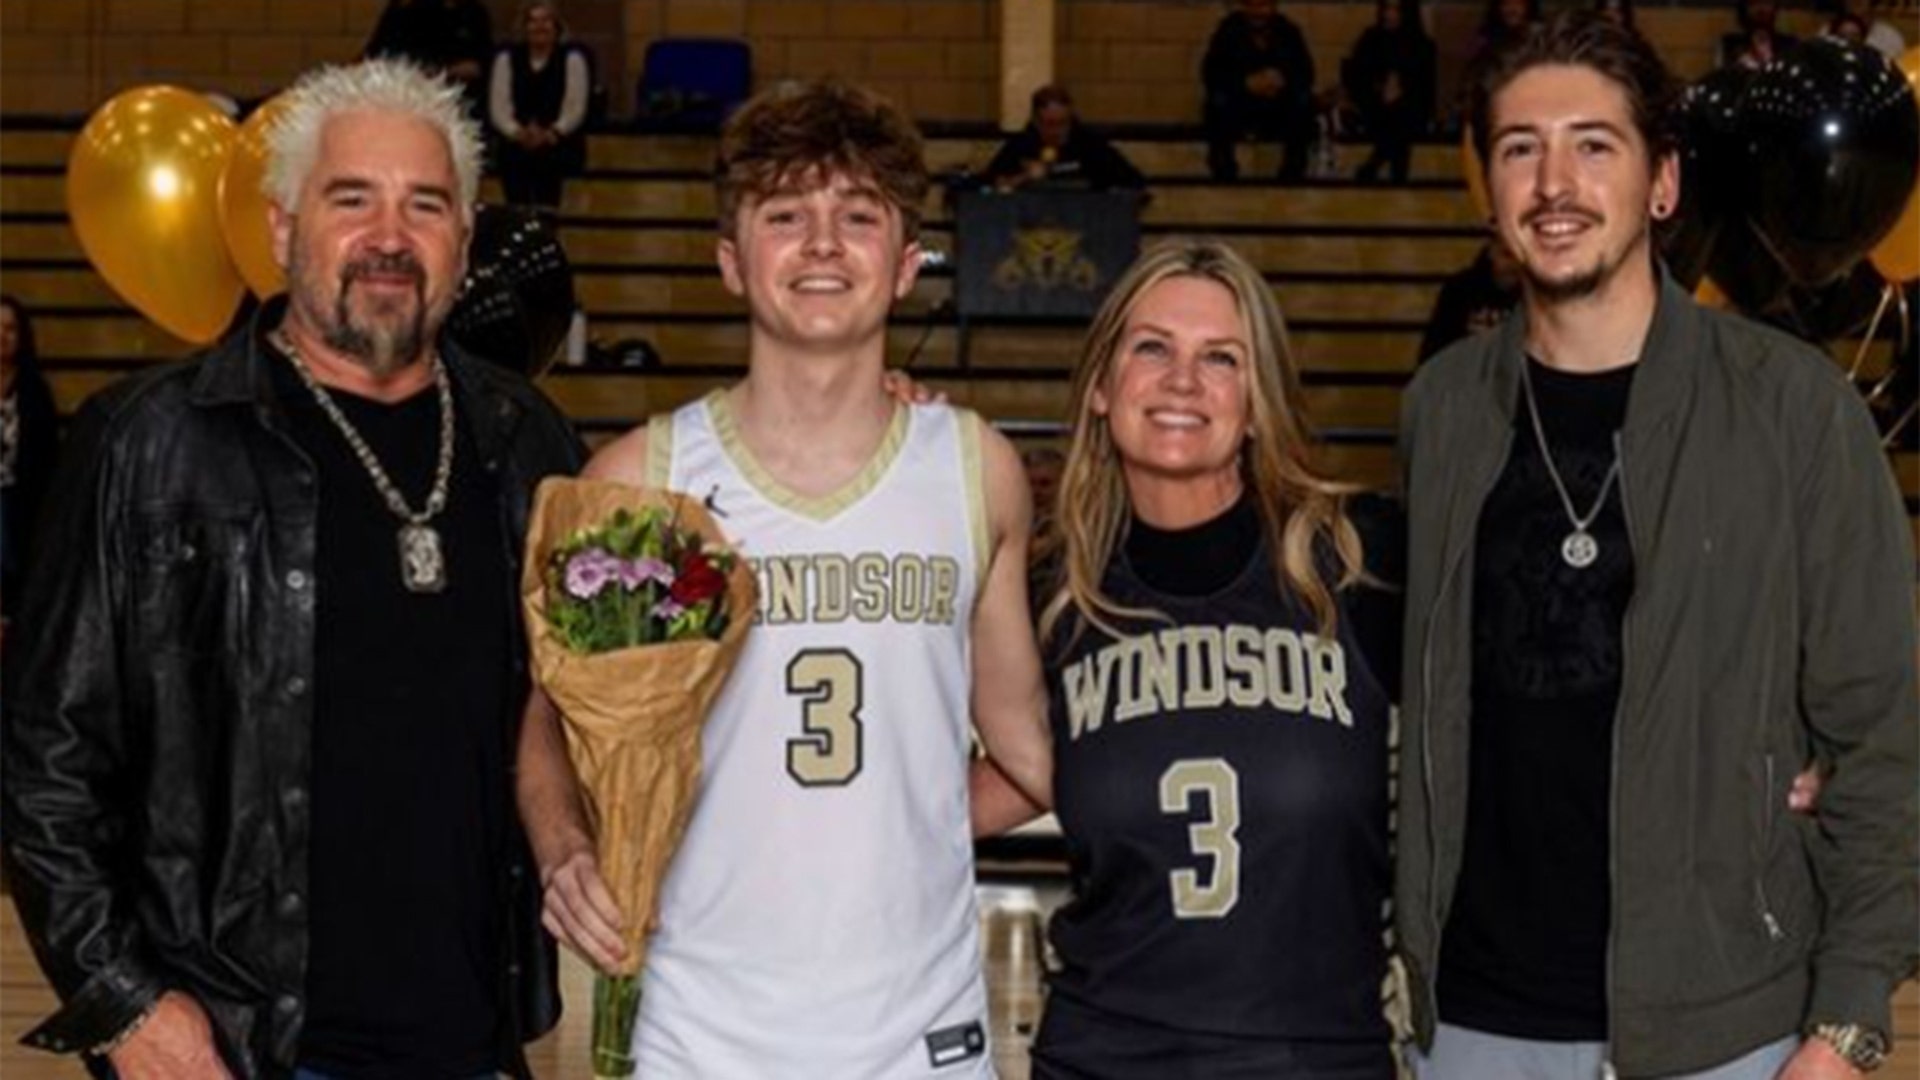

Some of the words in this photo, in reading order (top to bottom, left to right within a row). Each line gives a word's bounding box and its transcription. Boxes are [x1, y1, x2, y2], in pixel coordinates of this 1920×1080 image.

[749, 553, 959, 625] NDSOR
[786, 647, 863, 788] 3
[1063, 623, 1353, 741] WINDSOR
[1159, 757, 1240, 918] 3
